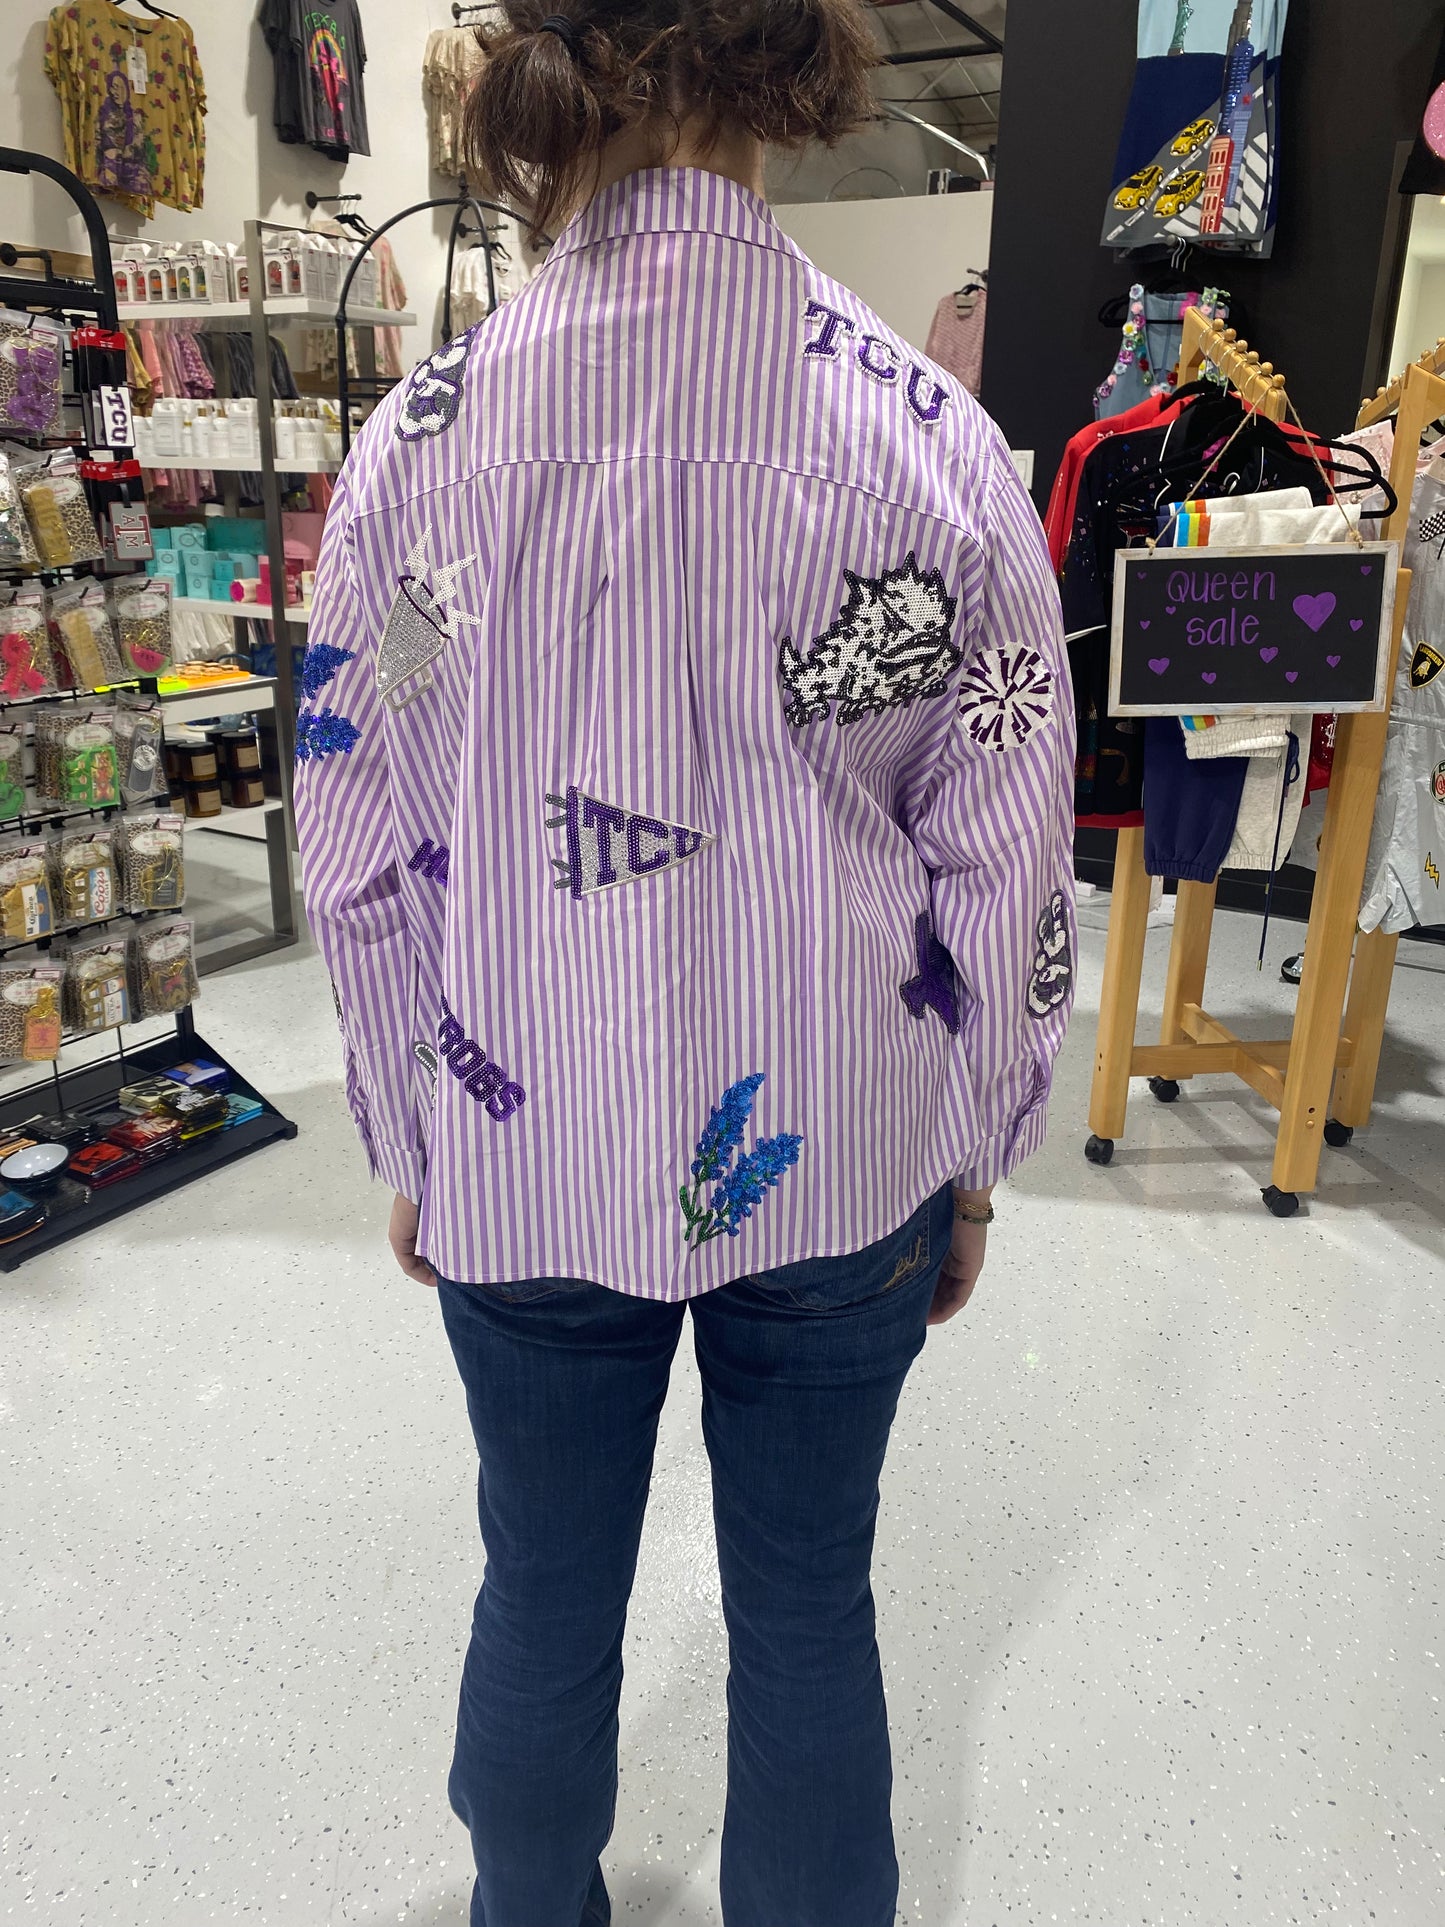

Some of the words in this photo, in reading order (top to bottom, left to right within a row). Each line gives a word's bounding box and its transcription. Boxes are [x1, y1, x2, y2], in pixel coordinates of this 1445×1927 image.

[803, 297, 952, 425] TCU
[106, 393, 128, 444] TCU
[1166, 570, 1276, 604] Queen
[1185, 607, 1260, 647] sale
[582, 796, 703, 887] TCU
[94, 869, 106, 915] Coors
[438, 986, 526, 1122] ROGS
